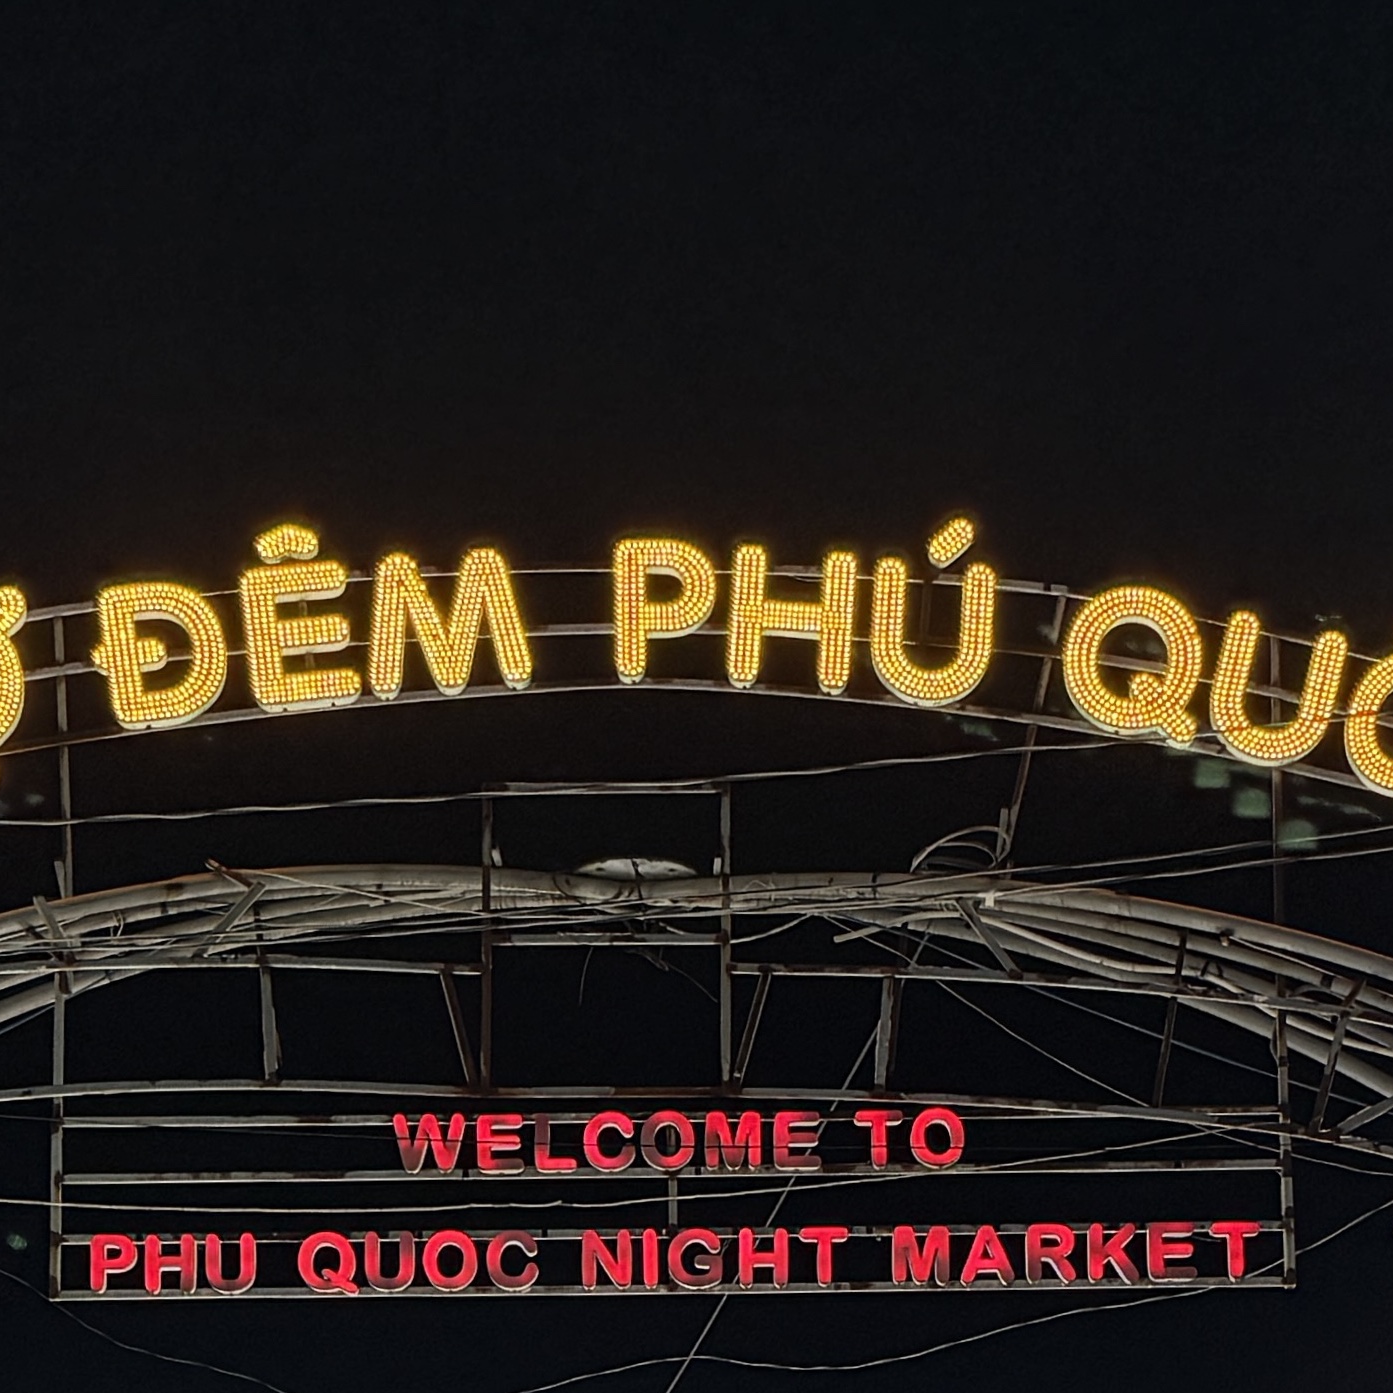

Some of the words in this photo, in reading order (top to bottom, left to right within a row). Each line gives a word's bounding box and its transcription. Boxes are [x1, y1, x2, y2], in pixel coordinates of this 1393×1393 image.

[91, 522, 534, 730] ĐÊM
[612, 515, 997, 707] PHÚ
[392, 1108, 820, 1174] WELCOME
[854, 1106, 966, 1170] TO
[88, 1231, 258, 1295] PHU
[297, 1227, 539, 1296] QUOC
[580, 1223, 849, 1292] NIGHT
[891, 1219, 1261, 1287] MARKET
